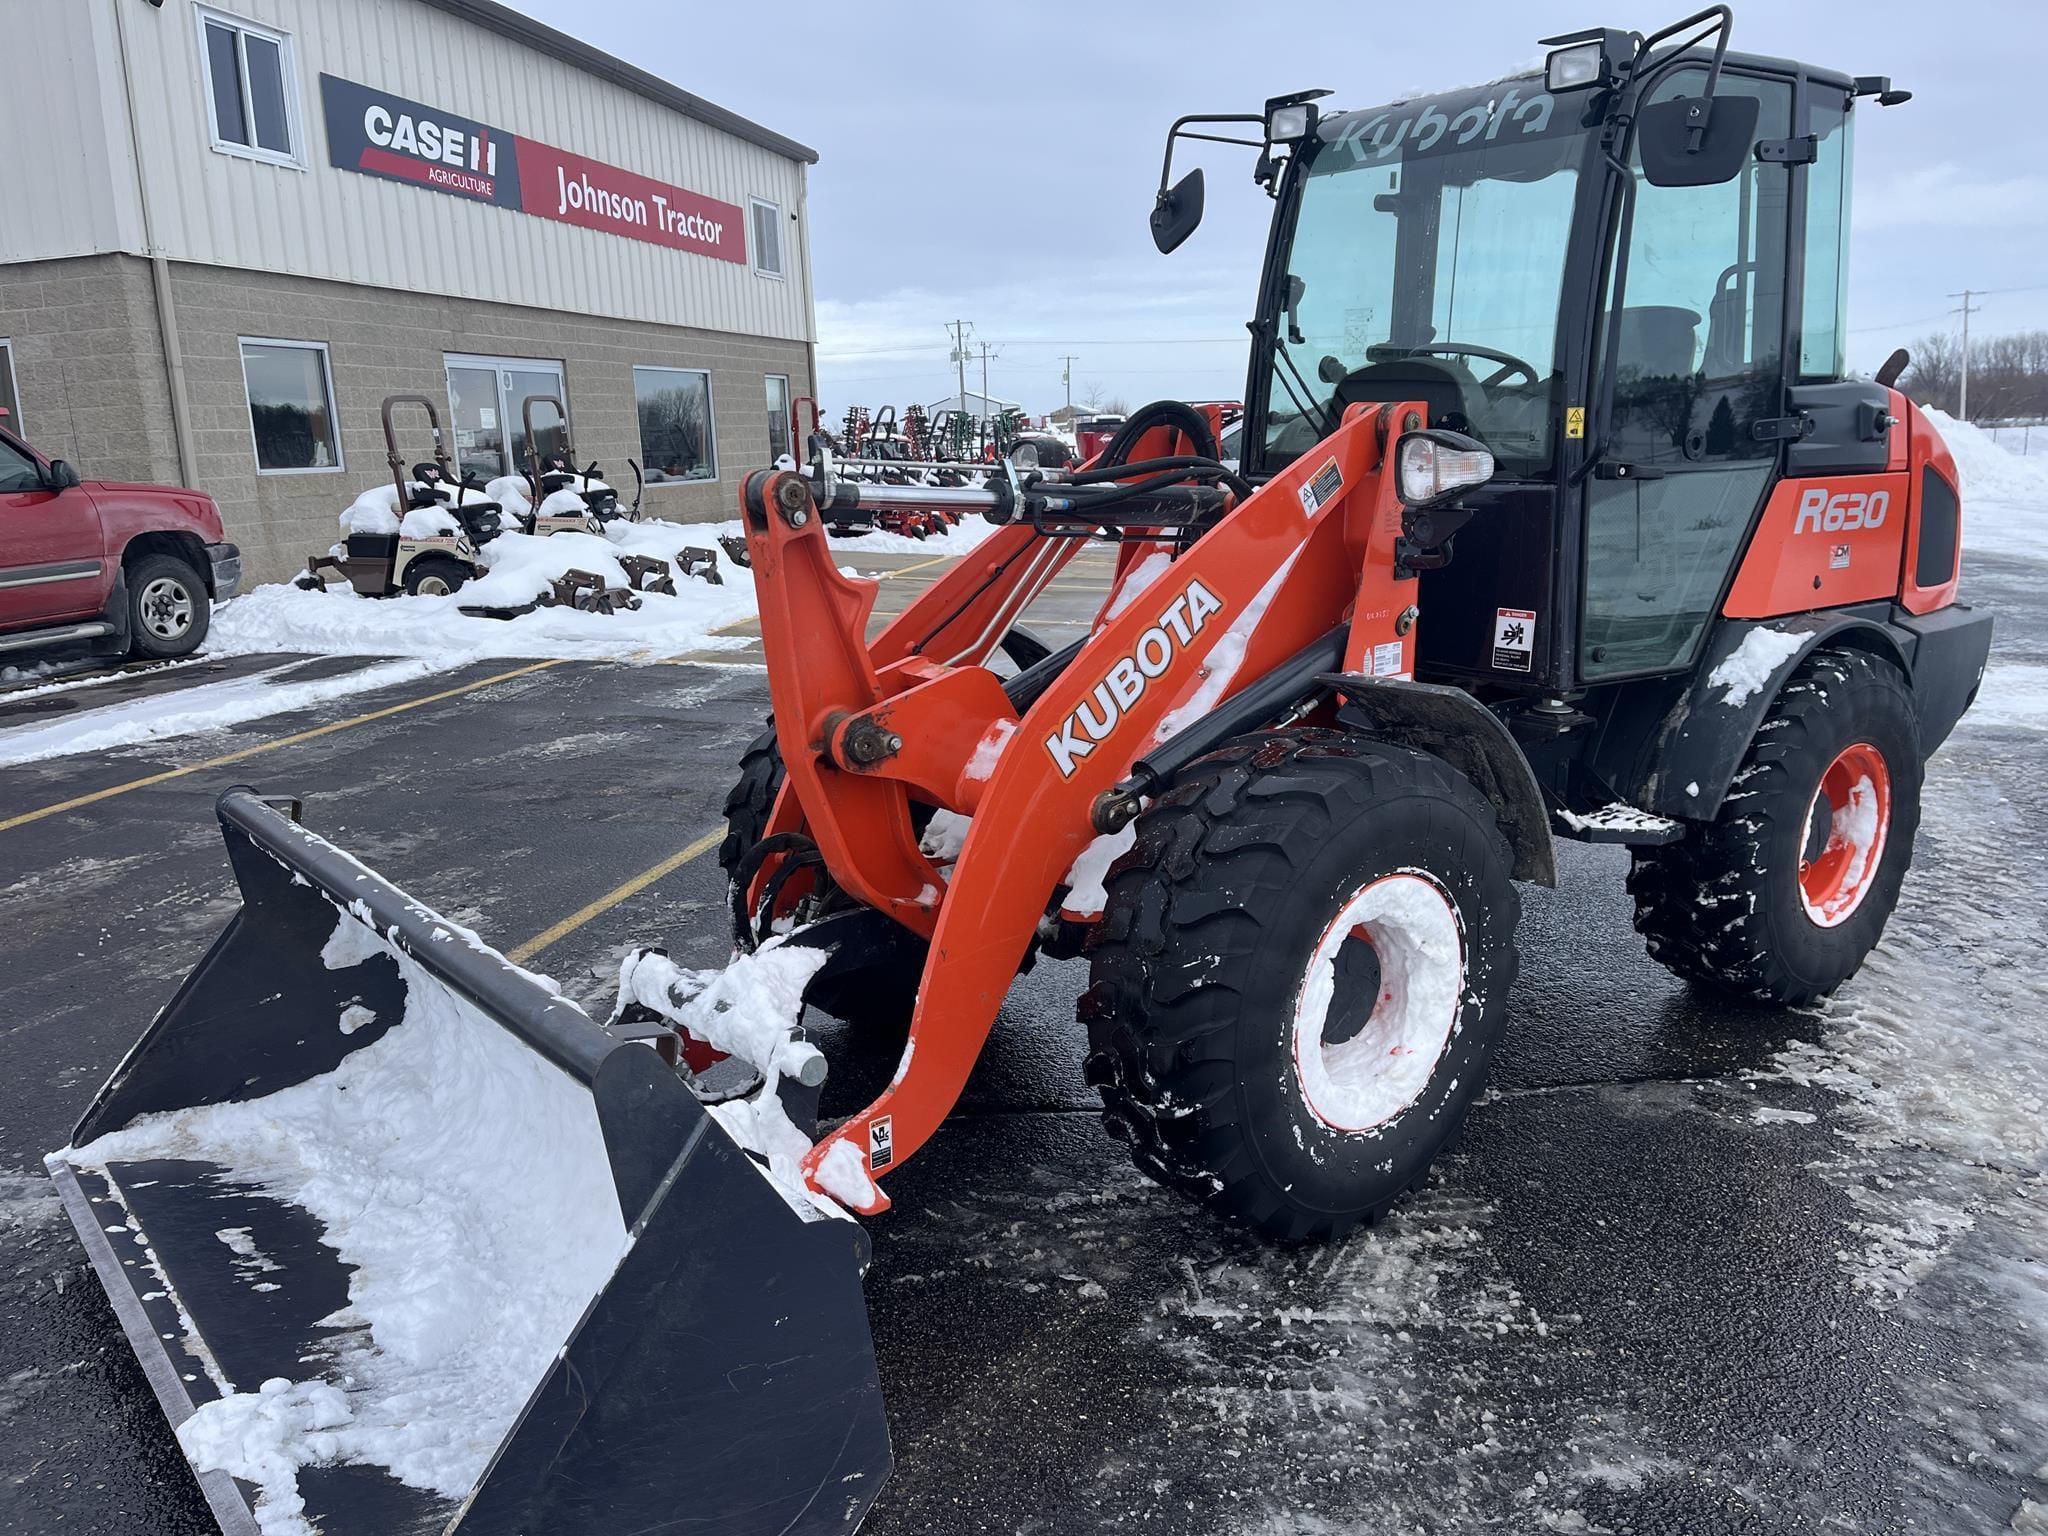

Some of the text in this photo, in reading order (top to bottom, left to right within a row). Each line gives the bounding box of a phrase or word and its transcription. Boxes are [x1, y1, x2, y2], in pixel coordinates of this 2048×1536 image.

[364, 105, 464, 167] CASE
[1333, 88, 1555, 162] Kubota
[428, 167, 492, 196] AGRICULTURE
[557, 165, 723, 245] Johnson Tractor
[1793, 488, 1890, 535] R630
[1044, 578, 1223, 778] KUBOTA
